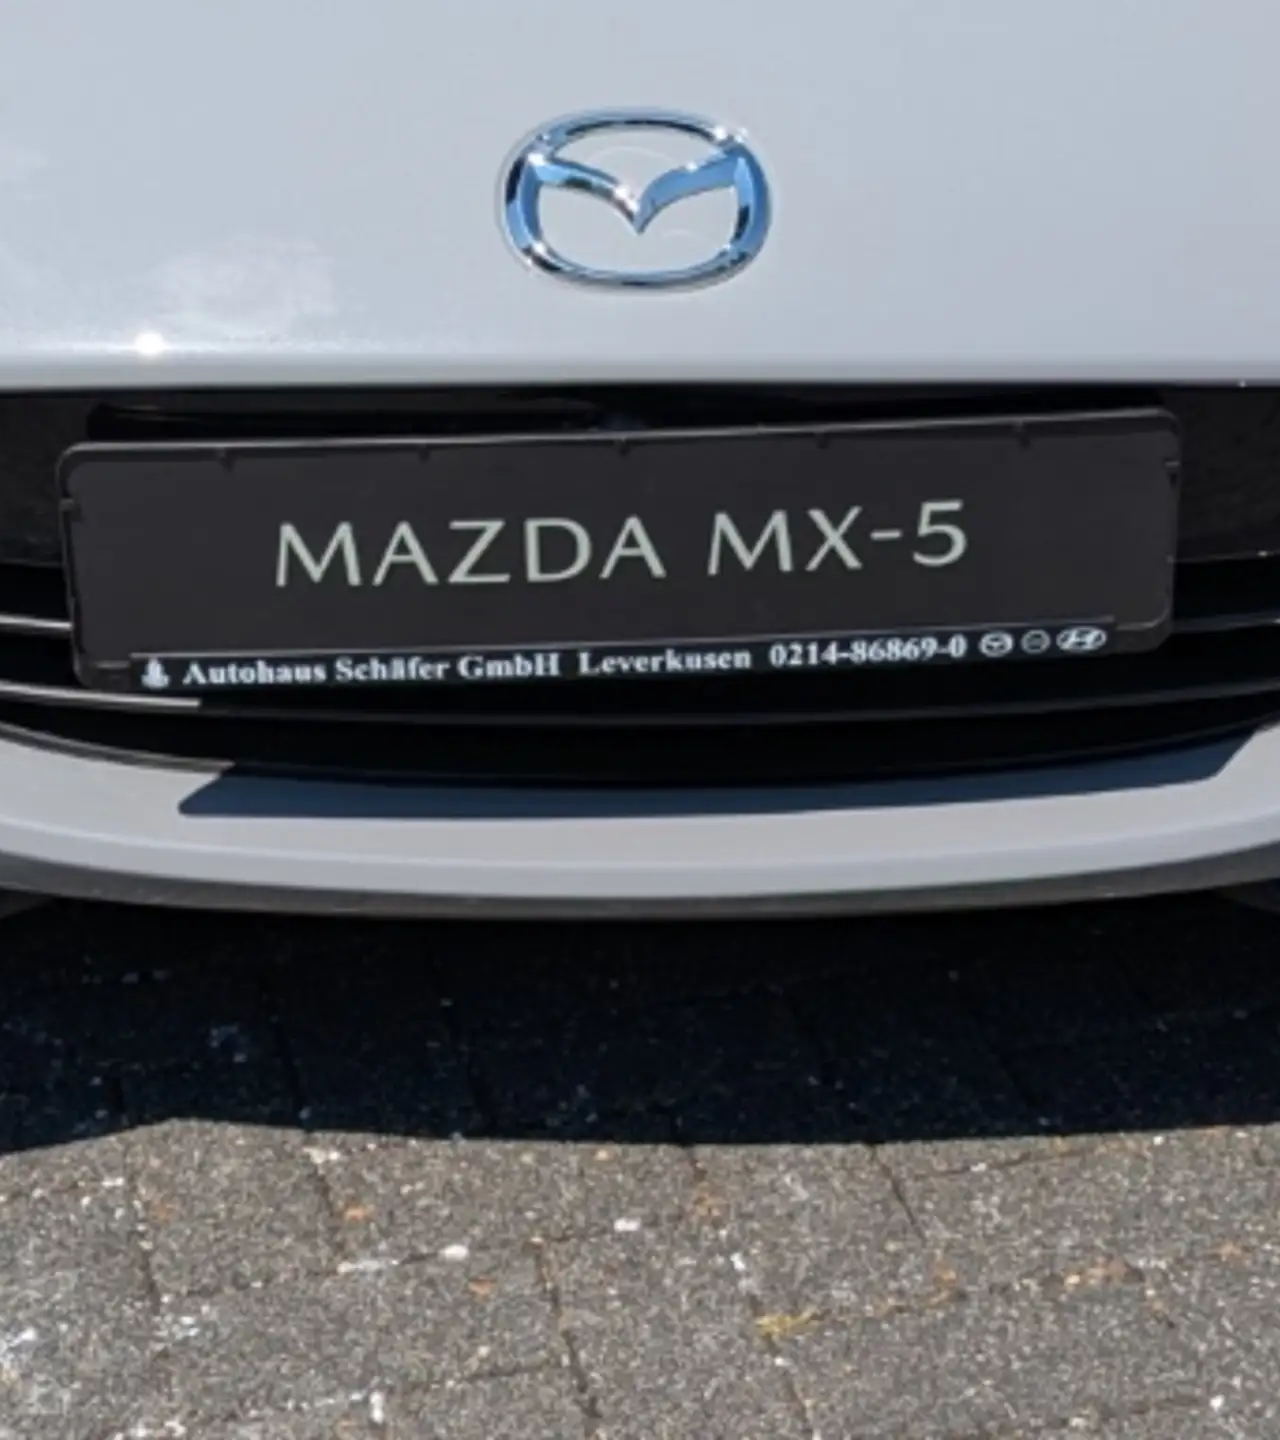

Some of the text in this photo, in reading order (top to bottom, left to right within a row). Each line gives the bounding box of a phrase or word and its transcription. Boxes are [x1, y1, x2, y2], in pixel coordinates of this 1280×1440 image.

[276, 499, 969, 587] MAZDA MX-5
[182, 635, 968, 686] Autohaus Schäfer GmbH Leverkusen 0214-86869-0
